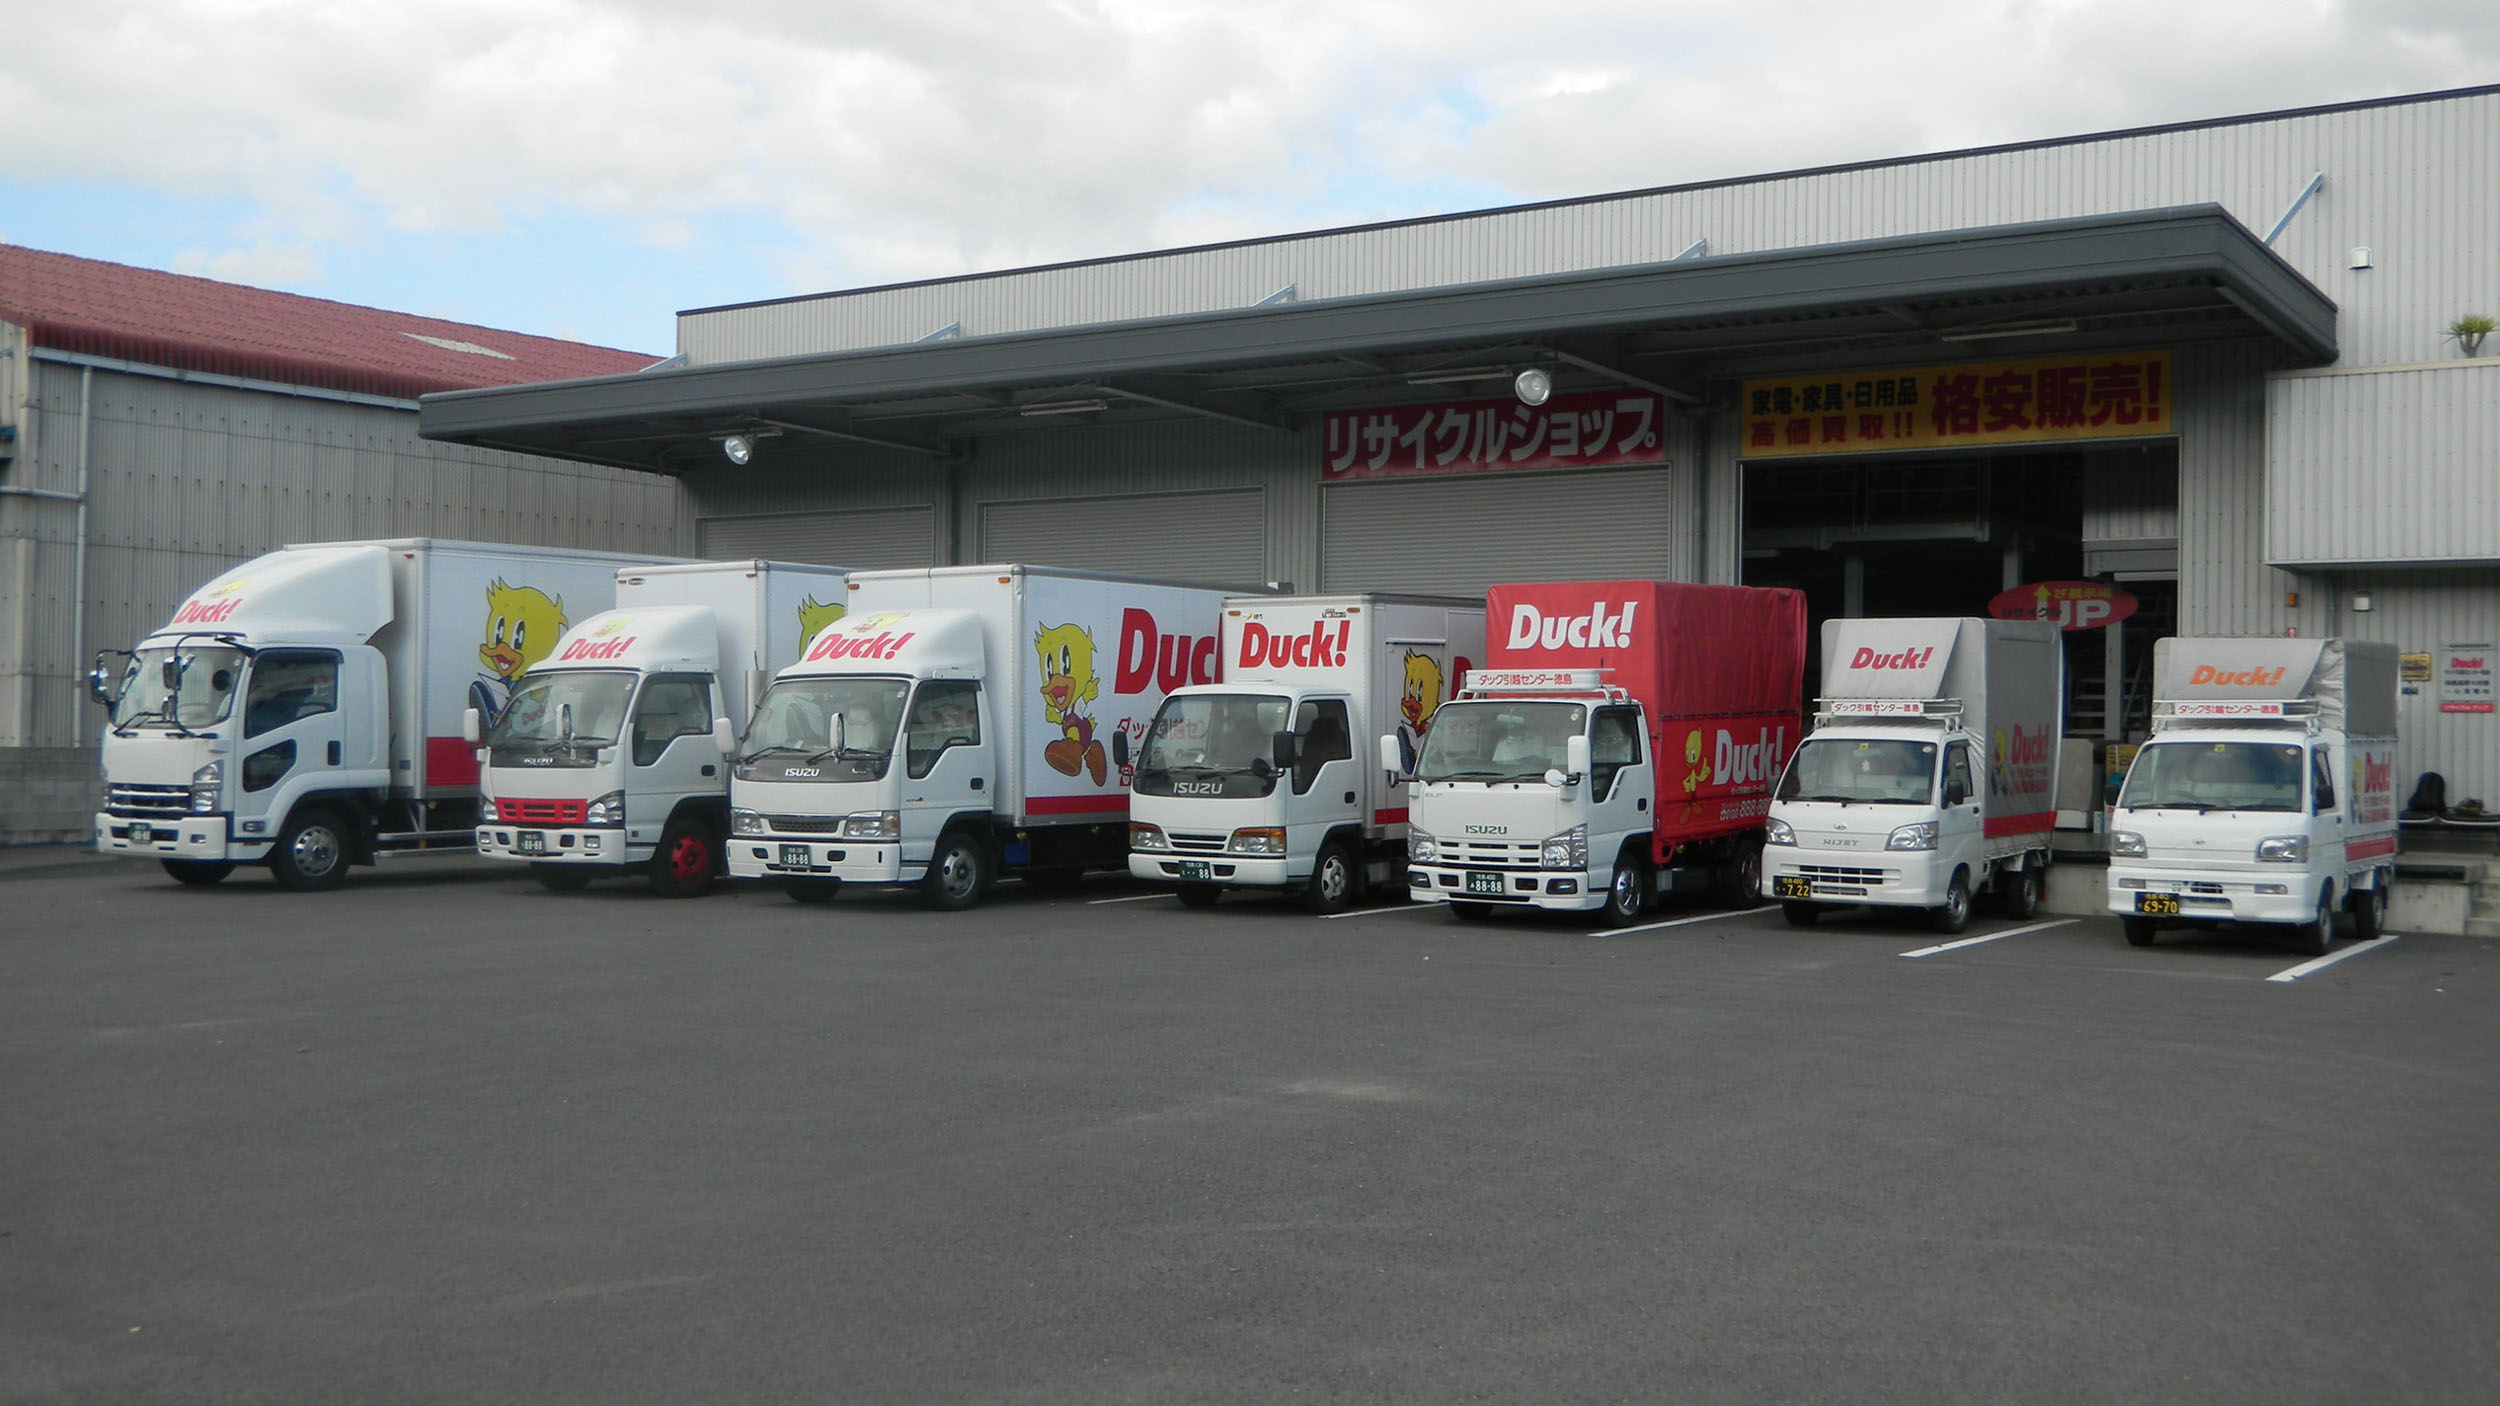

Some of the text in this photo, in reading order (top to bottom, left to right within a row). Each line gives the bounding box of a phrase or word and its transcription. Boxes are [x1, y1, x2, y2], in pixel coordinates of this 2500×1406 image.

[173, 598, 244, 625] Duck!
[1505, 601, 1639, 650] Duck!
[560, 636, 637, 661] Duck!
[806, 631, 916, 663] Duck!
[1114, 607, 1224, 697] Duc
[1238, 620, 1351, 669] Duck!
[1849, 646, 1934, 670] Duck!
[2189, 664, 2287, 686] Duck!
[1711, 725, 1785, 786] Duck!
[785, 768, 820, 777] ISUZU
[1173, 782, 1223, 795] ISUZU
[1465, 825, 1508, 835] ISUZU
[1823, 839, 1859, 847] HIJET
[787, 853, 809, 865] 88-88
[1475, 880, 1502, 893] 88-88
[2143, 900, 2178, 914] 69-70
